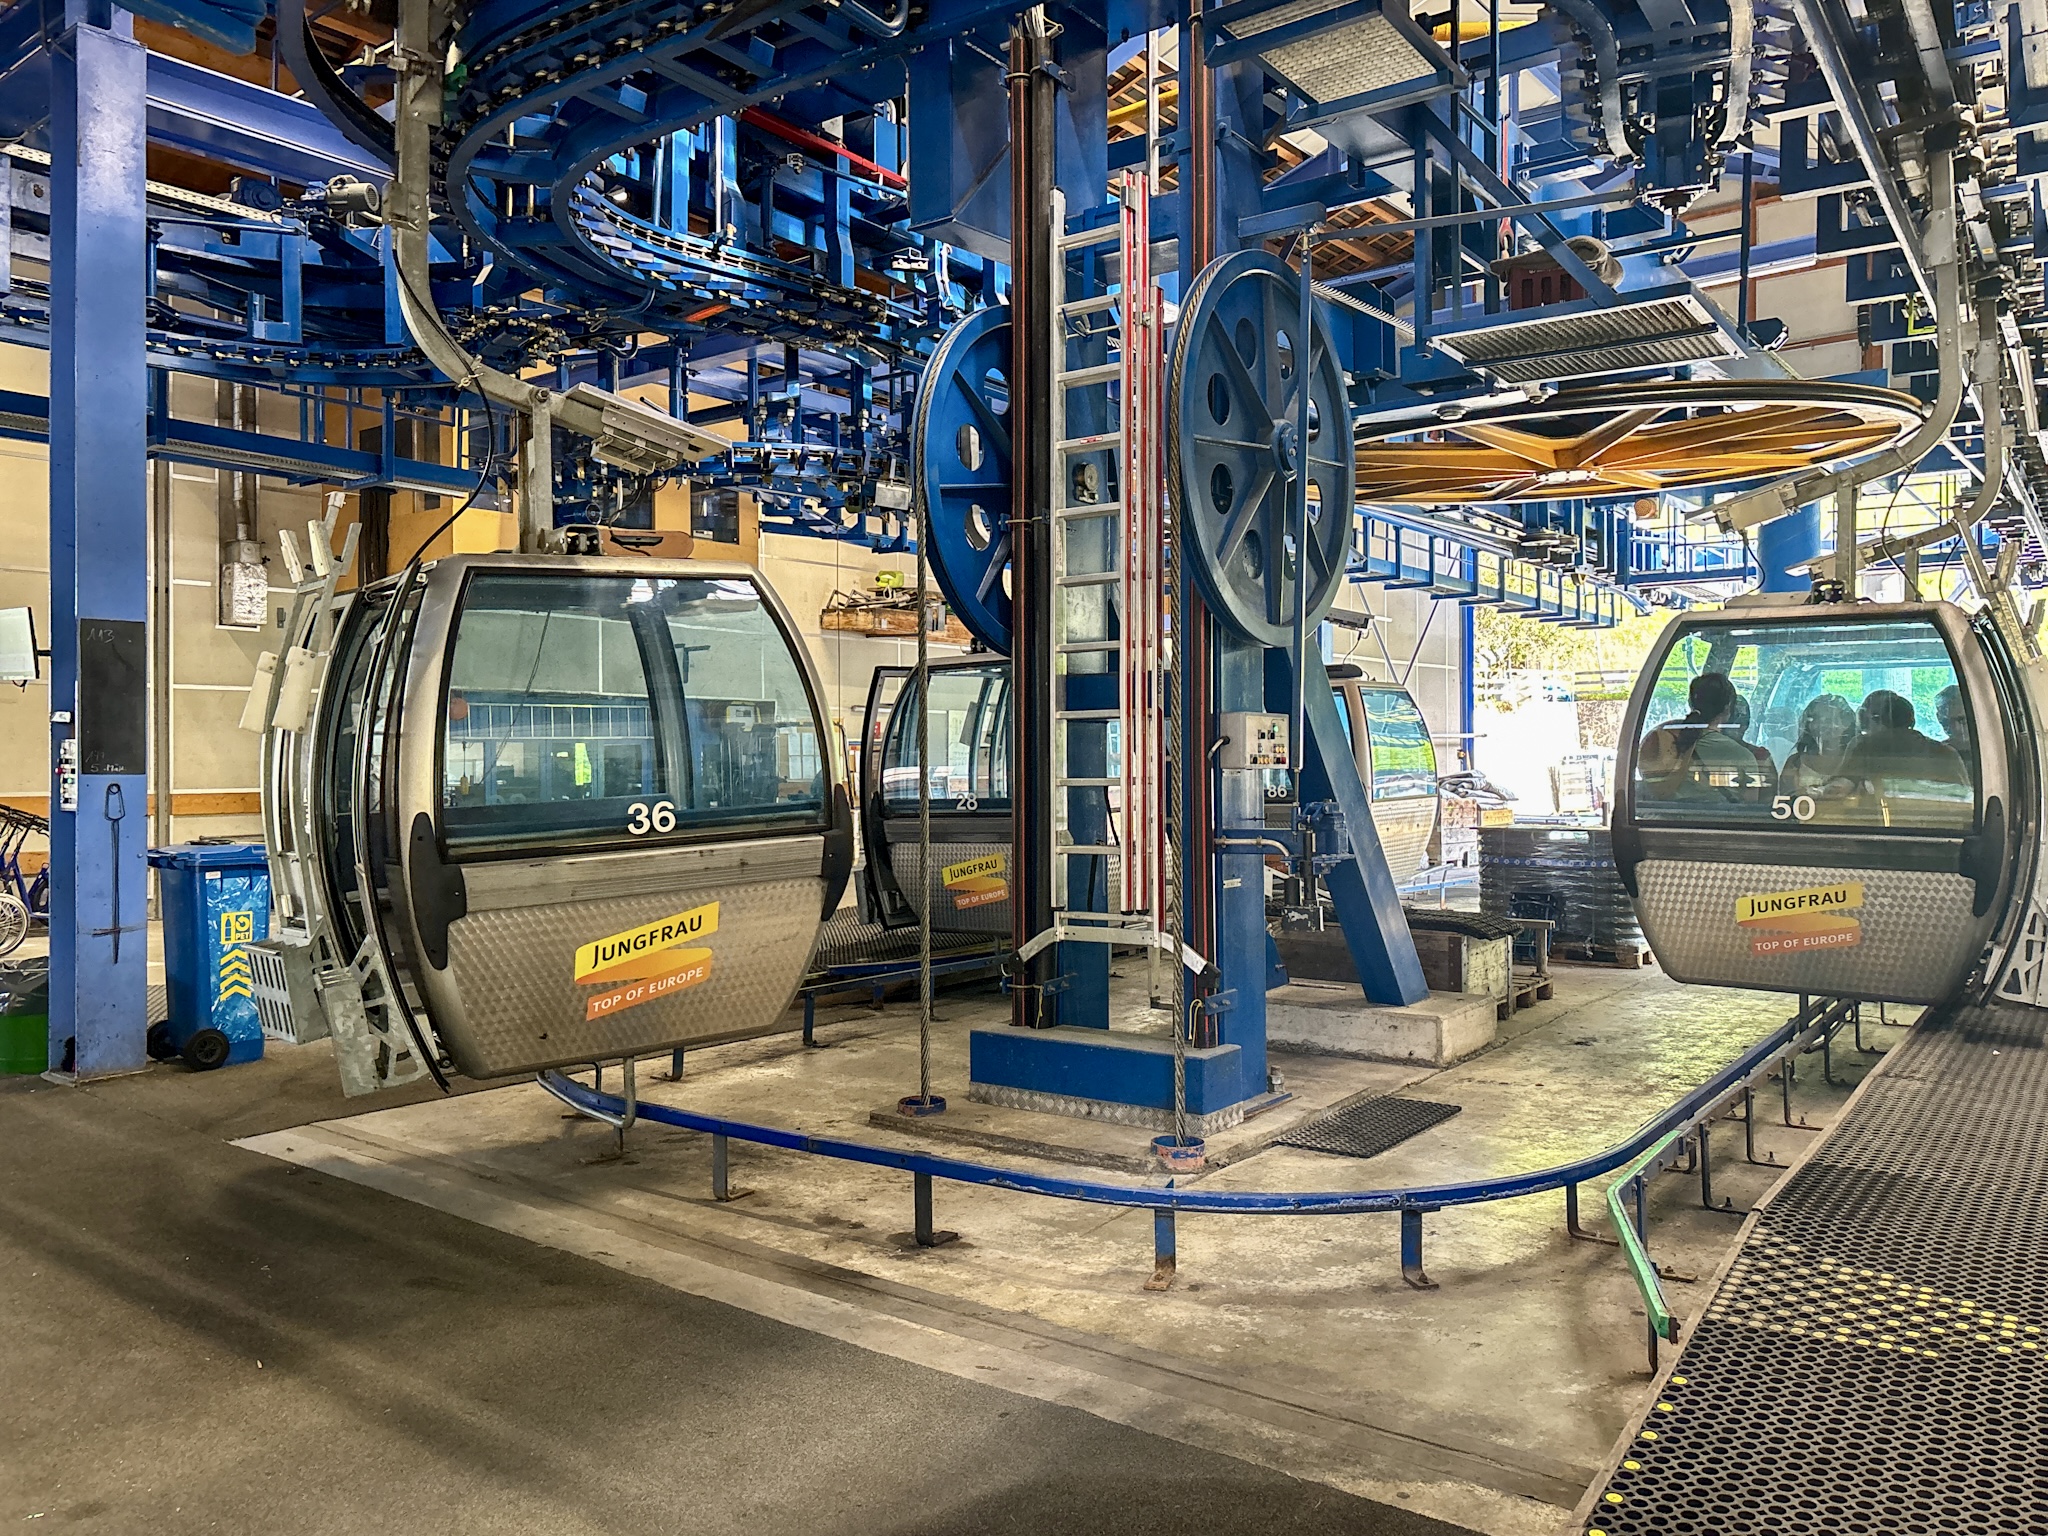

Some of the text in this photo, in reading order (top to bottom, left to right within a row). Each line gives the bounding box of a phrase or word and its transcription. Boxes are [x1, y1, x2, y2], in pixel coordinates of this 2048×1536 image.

[956, 793, 978, 811] 28
[1267, 784, 1287, 798] 86
[628, 801, 676, 835] 36
[1770, 795, 1816, 821] 50
[949, 859, 998, 881] JUNGFRAU
[957, 889, 1005, 906] TOP OF EUROPE
[1750, 890, 1847, 917] JUNGFRAU
[236, 932, 250, 940] PET
[592, 915, 702, 969] JUNGFRAU
[1754, 933, 1853, 951] TOP OF EUROPE
[592, 967, 704, 1013] TOP OF EUROPE
